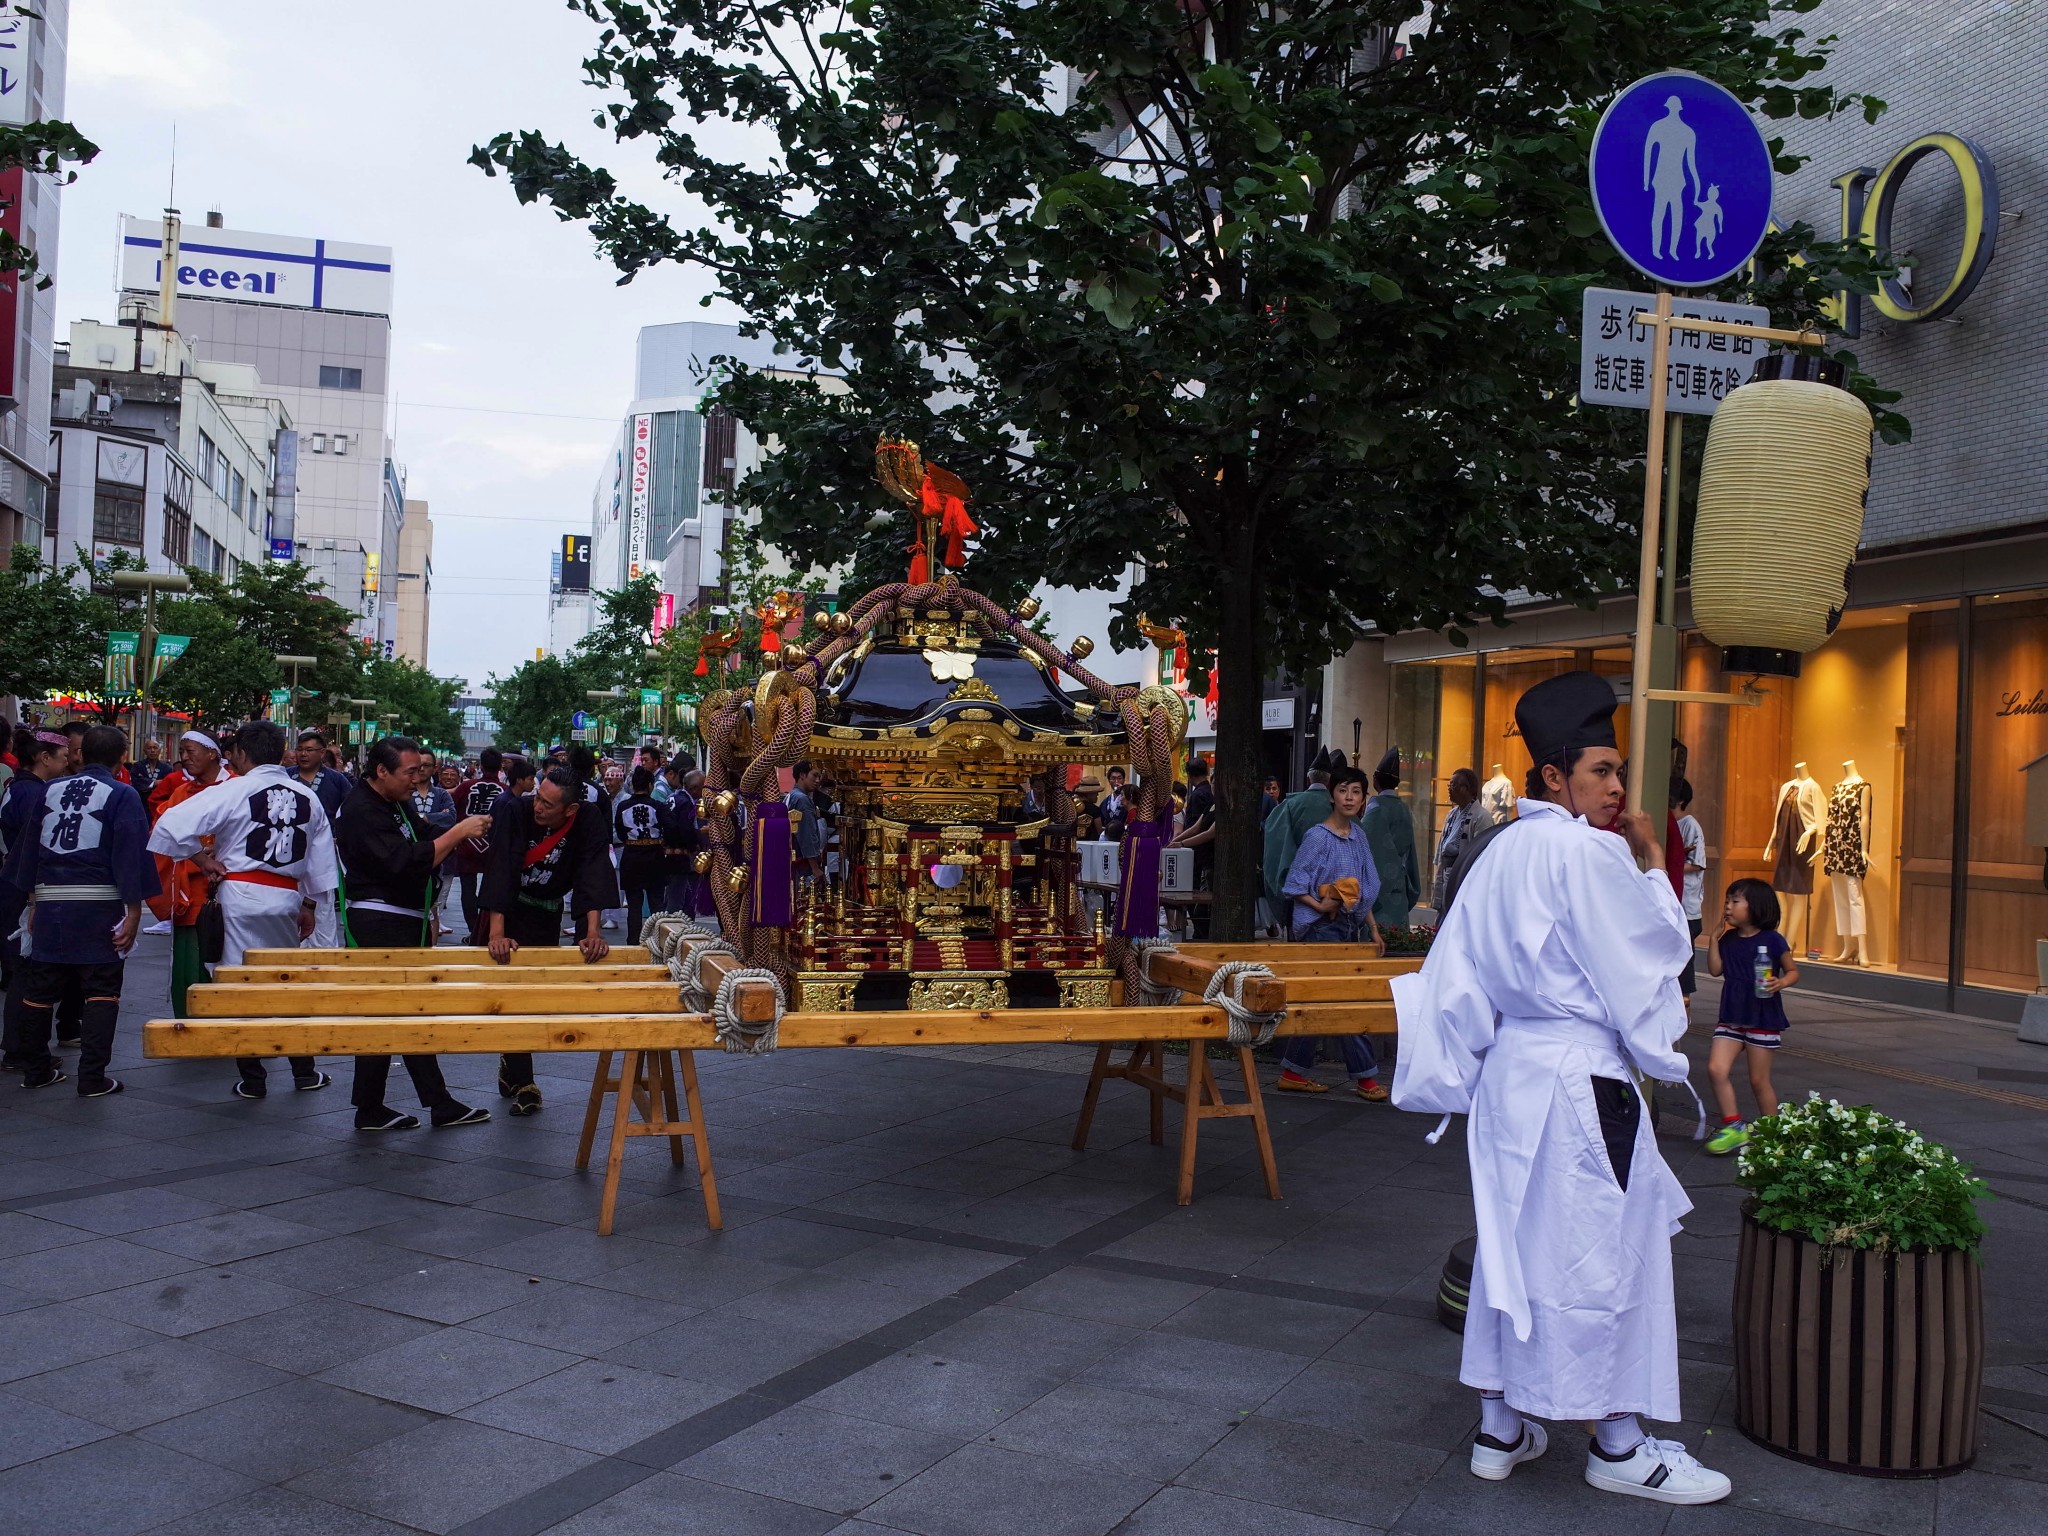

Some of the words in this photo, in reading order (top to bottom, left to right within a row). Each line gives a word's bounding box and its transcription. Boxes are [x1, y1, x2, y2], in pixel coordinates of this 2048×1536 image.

[1601, 304, 1753, 354] 歩行用道路
